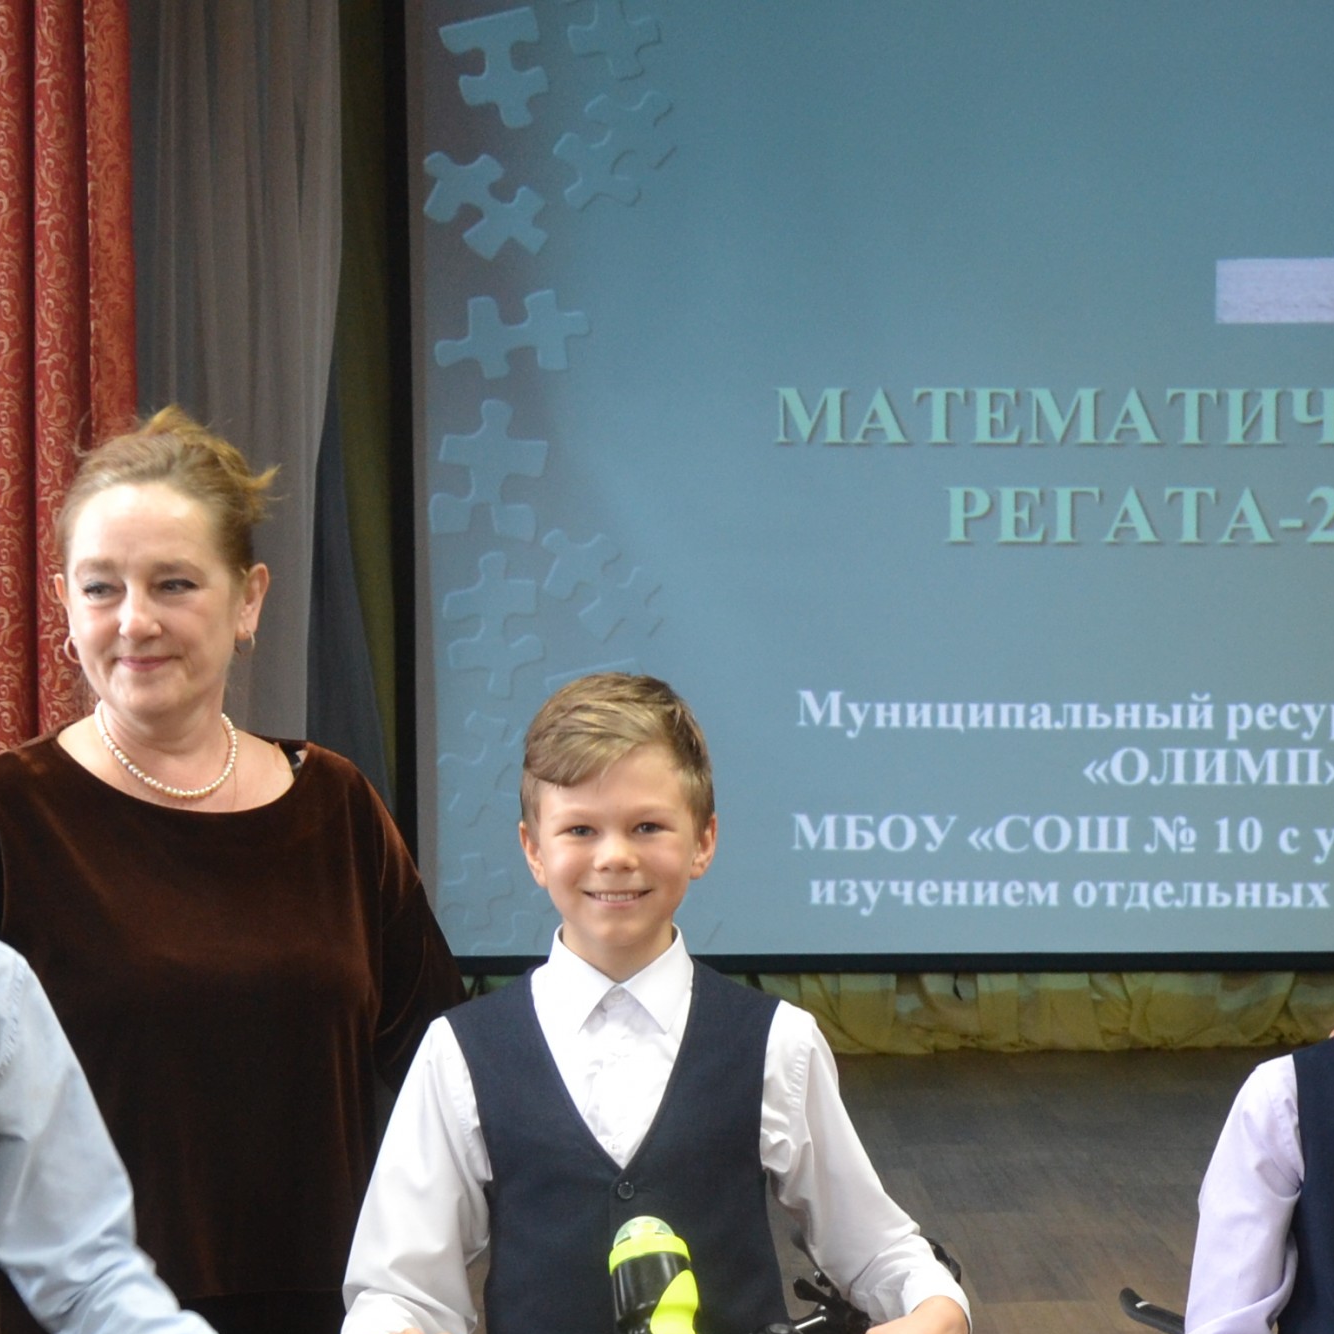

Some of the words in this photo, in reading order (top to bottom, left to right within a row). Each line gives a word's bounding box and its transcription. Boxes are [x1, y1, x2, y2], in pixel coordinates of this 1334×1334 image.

[797, 689, 1213, 737] Муниципальный
[792, 813, 956, 854] МБОУ
[968, 813, 1131, 854] «СОШ
[1144, 813, 1199, 855] №
[1217, 815, 1264, 854] 10
[1278, 825, 1302, 855] с
[809, 875, 1059, 913] изучением
[1073, 872, 1331, 911] отдельных
